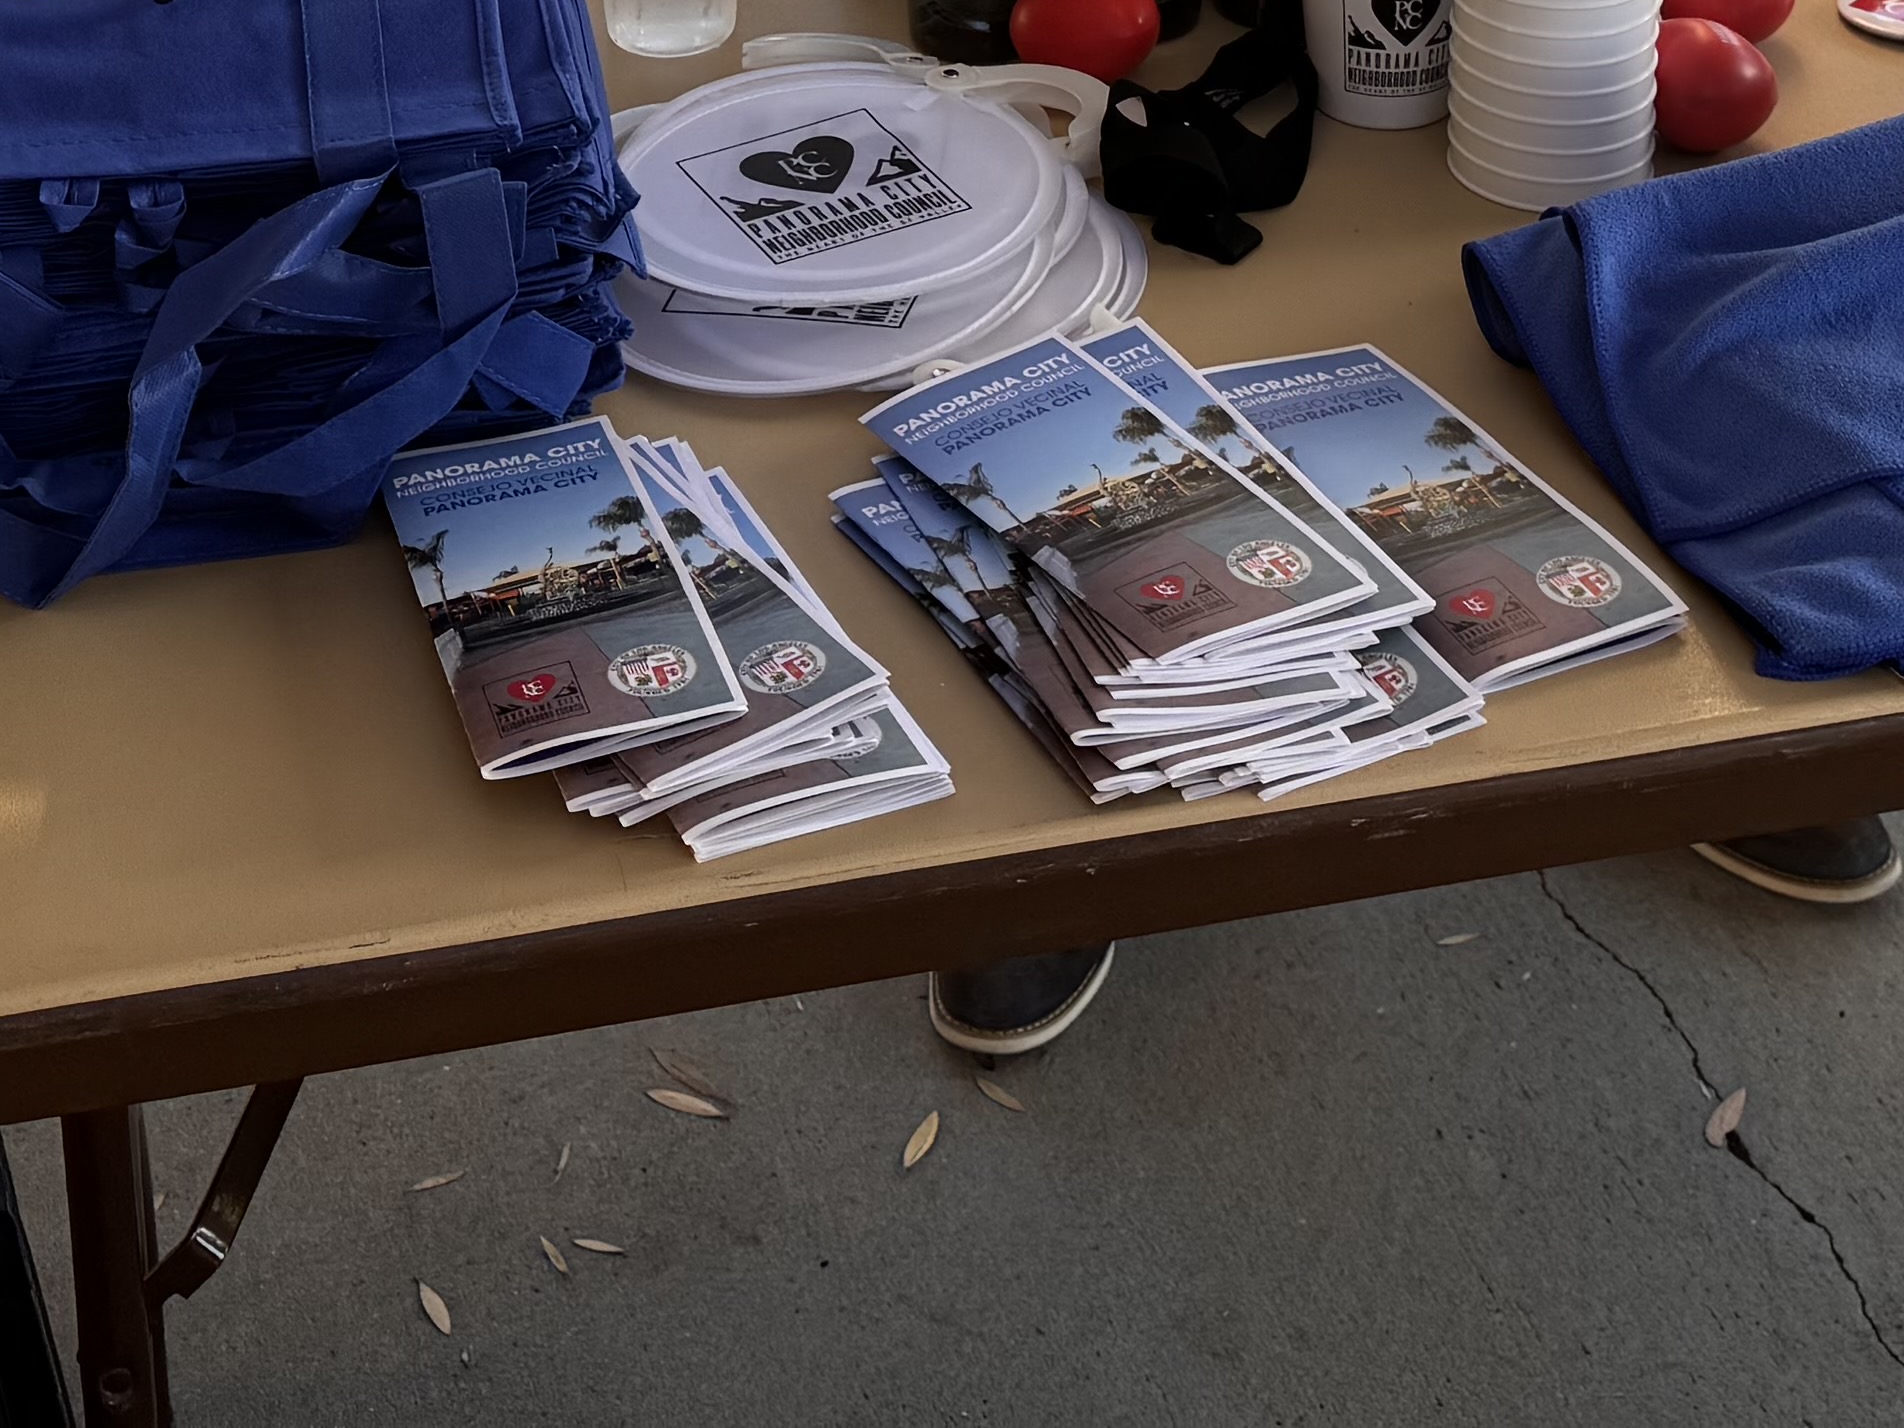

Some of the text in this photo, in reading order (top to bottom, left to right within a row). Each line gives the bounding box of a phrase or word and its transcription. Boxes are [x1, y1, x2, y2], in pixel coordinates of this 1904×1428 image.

[1348, 48, 1420, 70] PANORAMA
[748, 173, 937, 239] PANORAMA CITY
[762, 189, 958, 255] NEIGHBORHOOD COUNCIL
[1103, 343, 1152, 368] CITY
[893, 353, 1071, 438] PANORAMA CITY
[904, 389, 1019, 445] NEIGHBORHOOD
[1020, 363, 1085, 393] COUNCIL
[1221, 361, 1384, 401] ANORAMA CITY
[1234, 372, 1398, 409] IGHBORHOOD COUNCIL
[1364, 392, 1405, 408] CITY
[934, 407, 1013, 448] CONSEJO
[1014, 380, 1087, 412] VECINAL
[941, 387, 1092, 456] PANORAMA CITY
[392, 438, 601, 488] PANORAMA CITY
[396, 450, 609, 498] NEIGHBORHOOD COUNCIL
[420, 464, 596, 506] CONSEJO VECINAL
[423, 472, 599, 516] PANORAMA CITY
